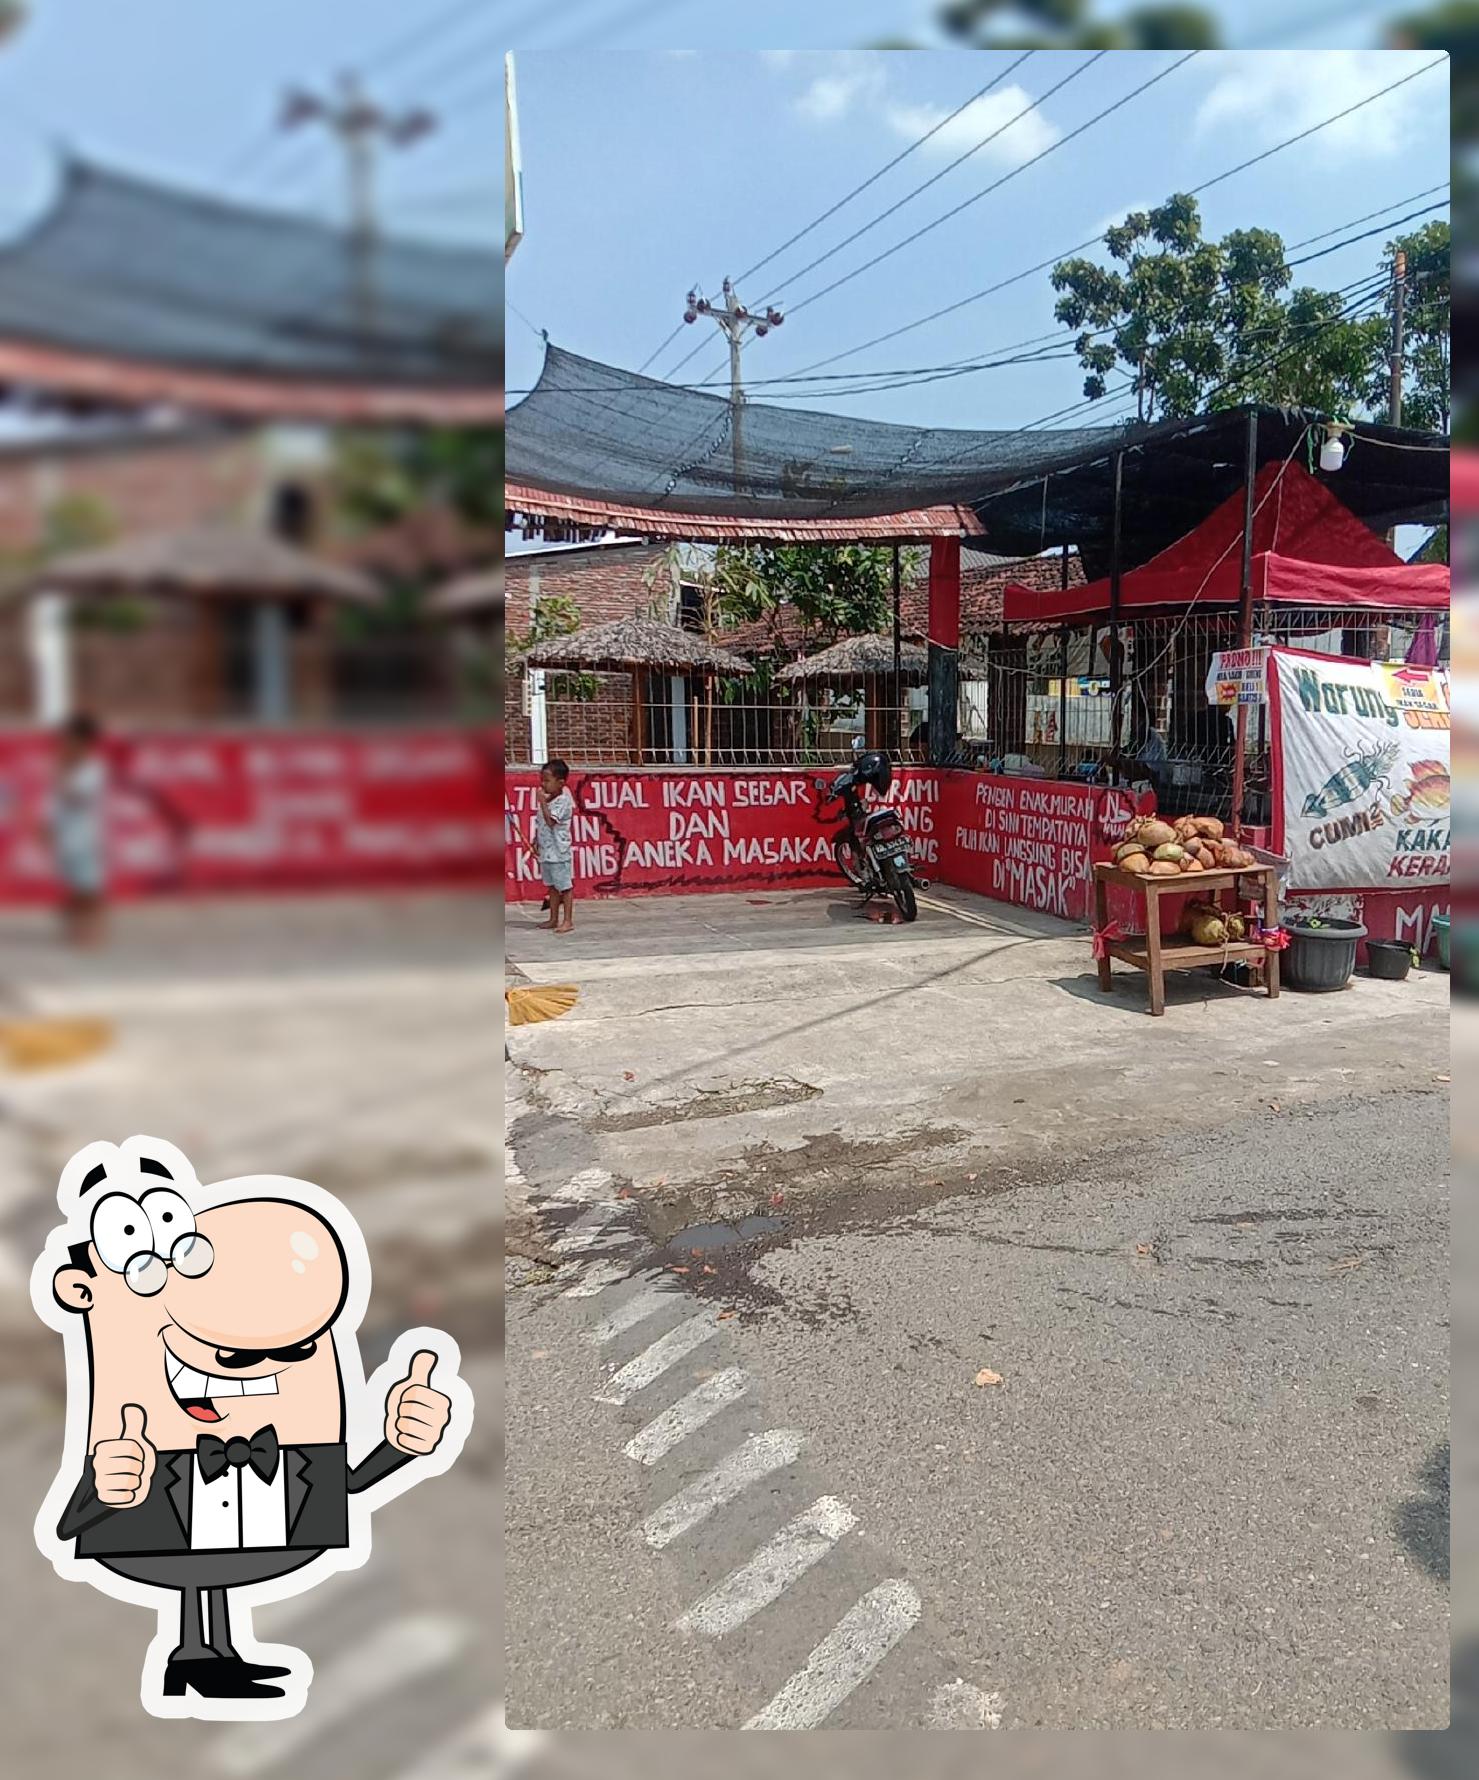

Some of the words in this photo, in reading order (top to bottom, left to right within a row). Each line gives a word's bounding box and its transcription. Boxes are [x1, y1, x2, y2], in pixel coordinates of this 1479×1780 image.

[584, 781, 650, 809] JUAL
[662, 781, 726, 808] IKAN
[732, 780, 811, 808] SEGAR
[669, 809, 730, 841] DAN
[984, 808, 996, 830] DI
[1020, 814, 1087, 847] TEMPATNYA
[622, 840, 714, 868] ANEKA
[1004, 836, 1056, 870] LANGSUNG
[1061, 847, 1093, 883] BISA
